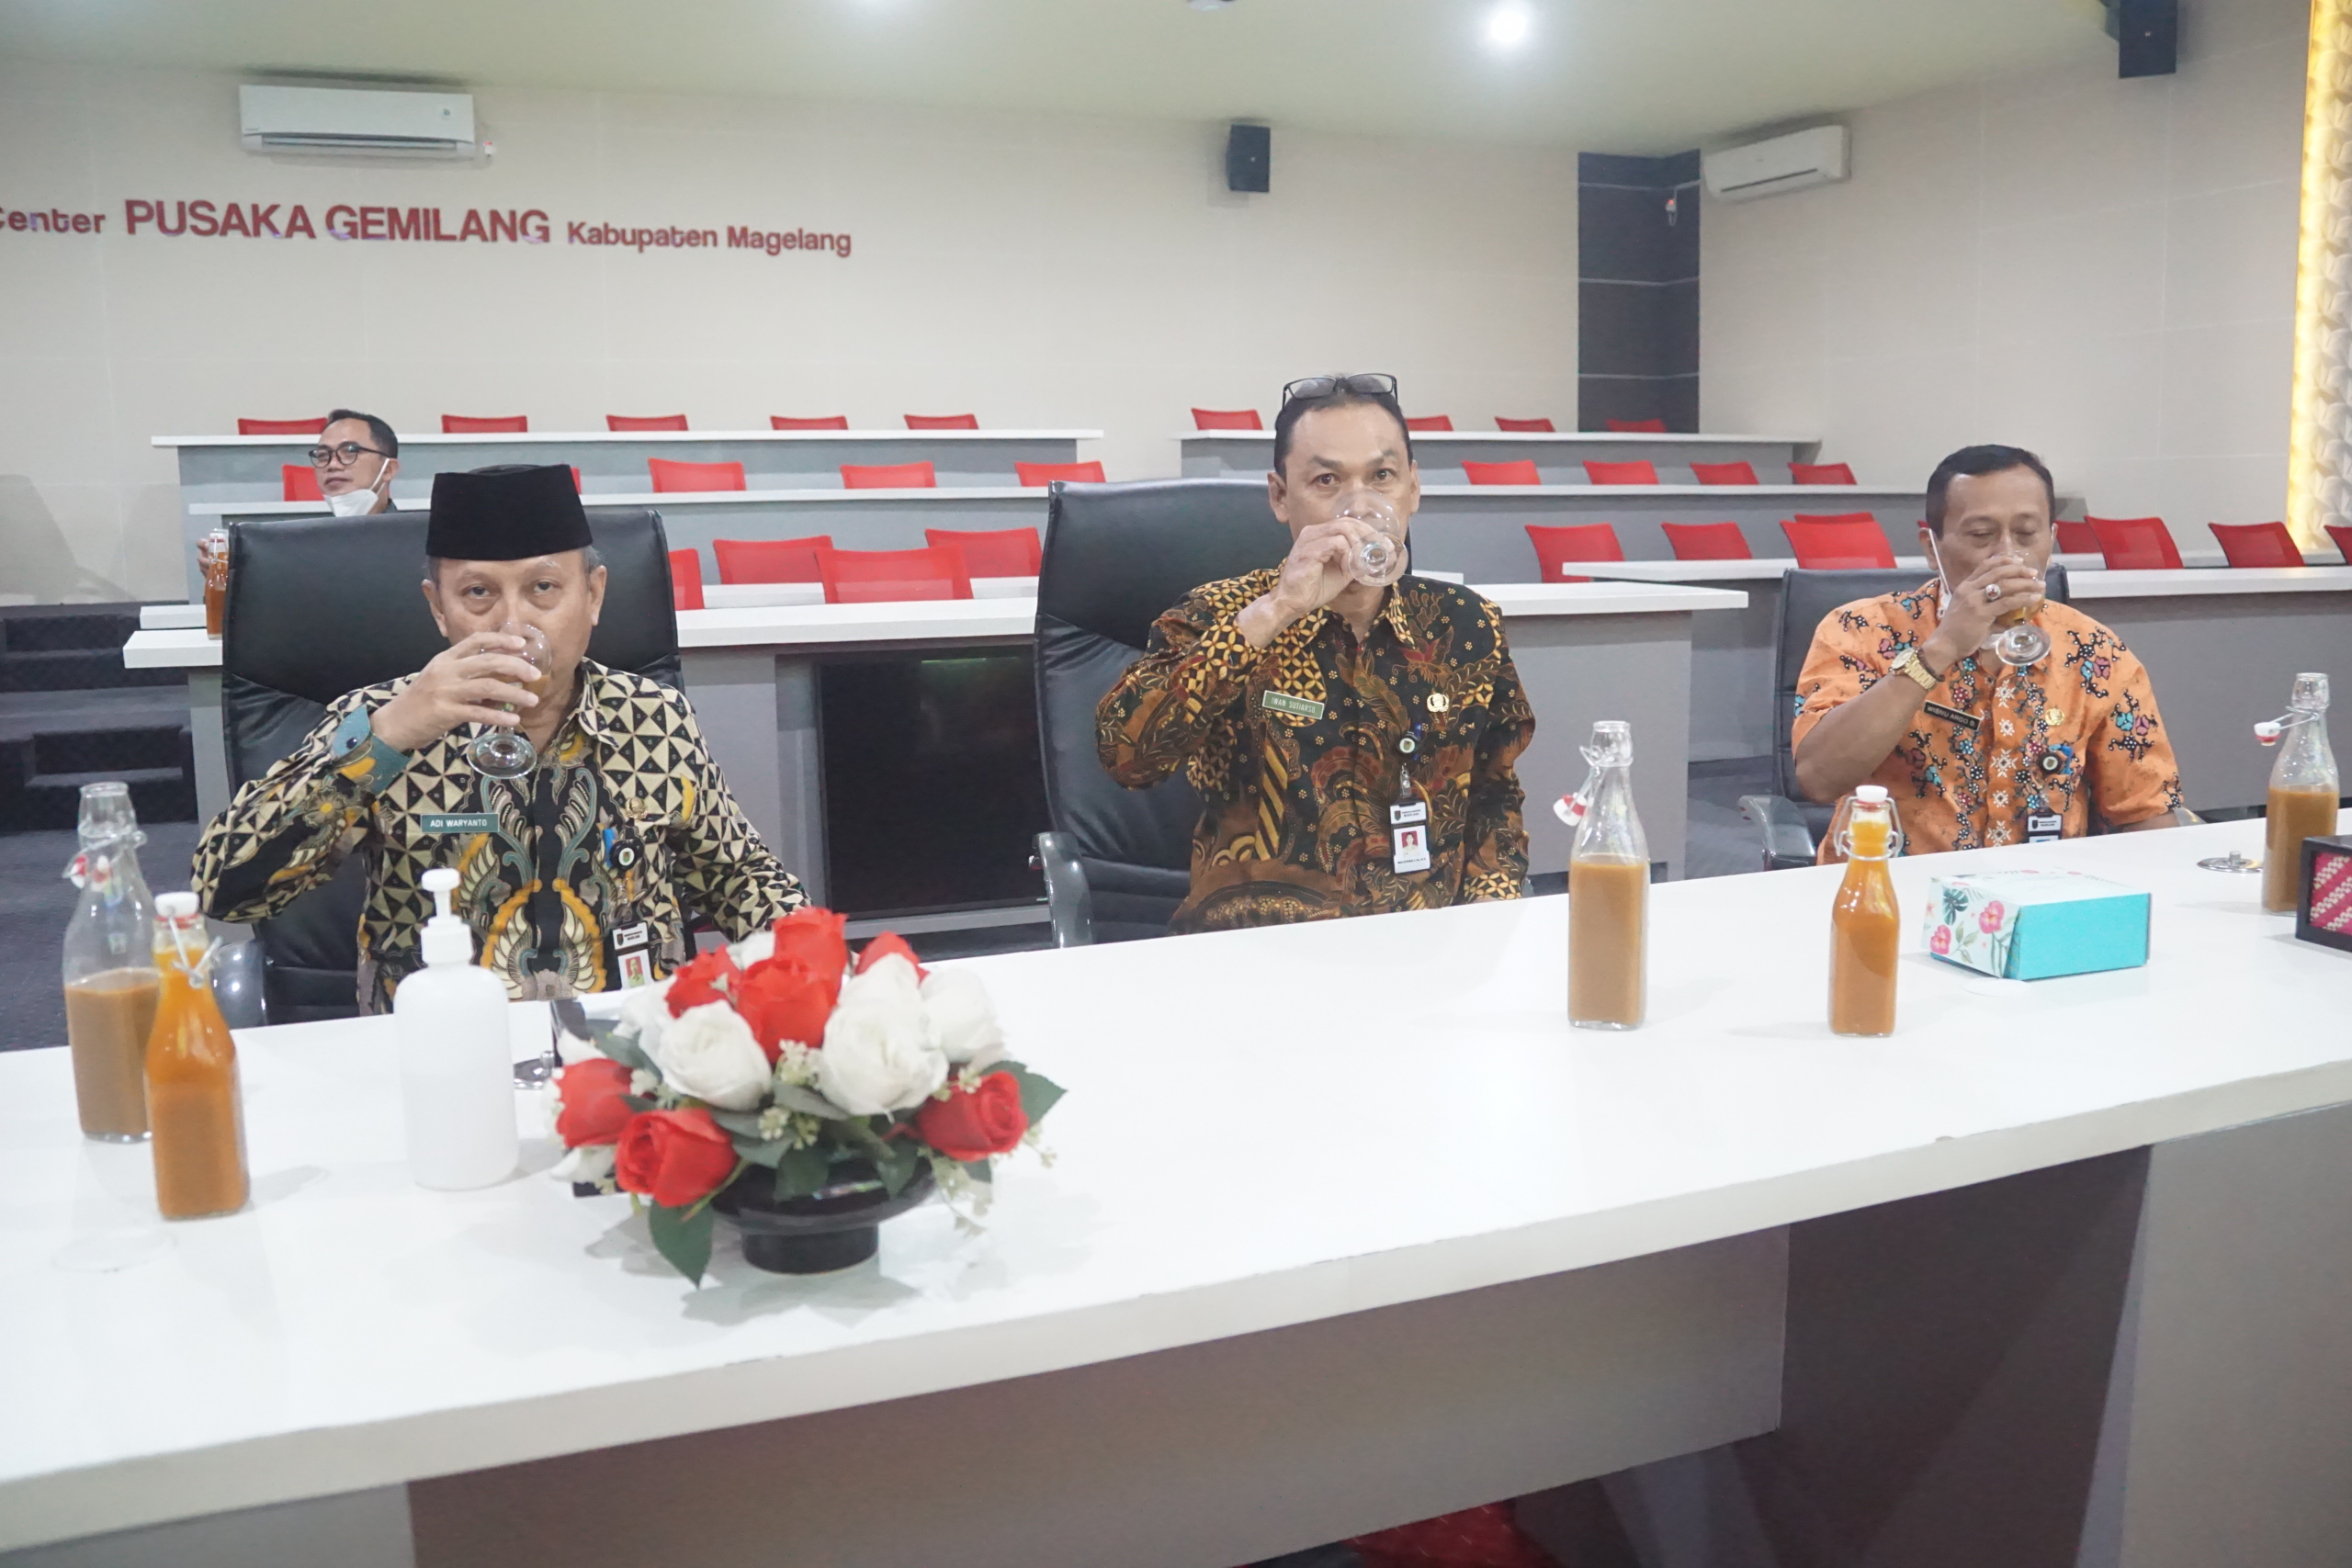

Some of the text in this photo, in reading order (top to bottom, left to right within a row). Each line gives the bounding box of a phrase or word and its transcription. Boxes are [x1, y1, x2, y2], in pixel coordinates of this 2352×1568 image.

[0, 199, 852, 258] enter PUSAKA GEMILANG Kabupaten Magelang
[1272, 697, 1316, 713] IWAN SUTIARSO
[1927, 705, 1949, 717] WISNU
[430, 818, 488, 828] ADI WARYANTO
